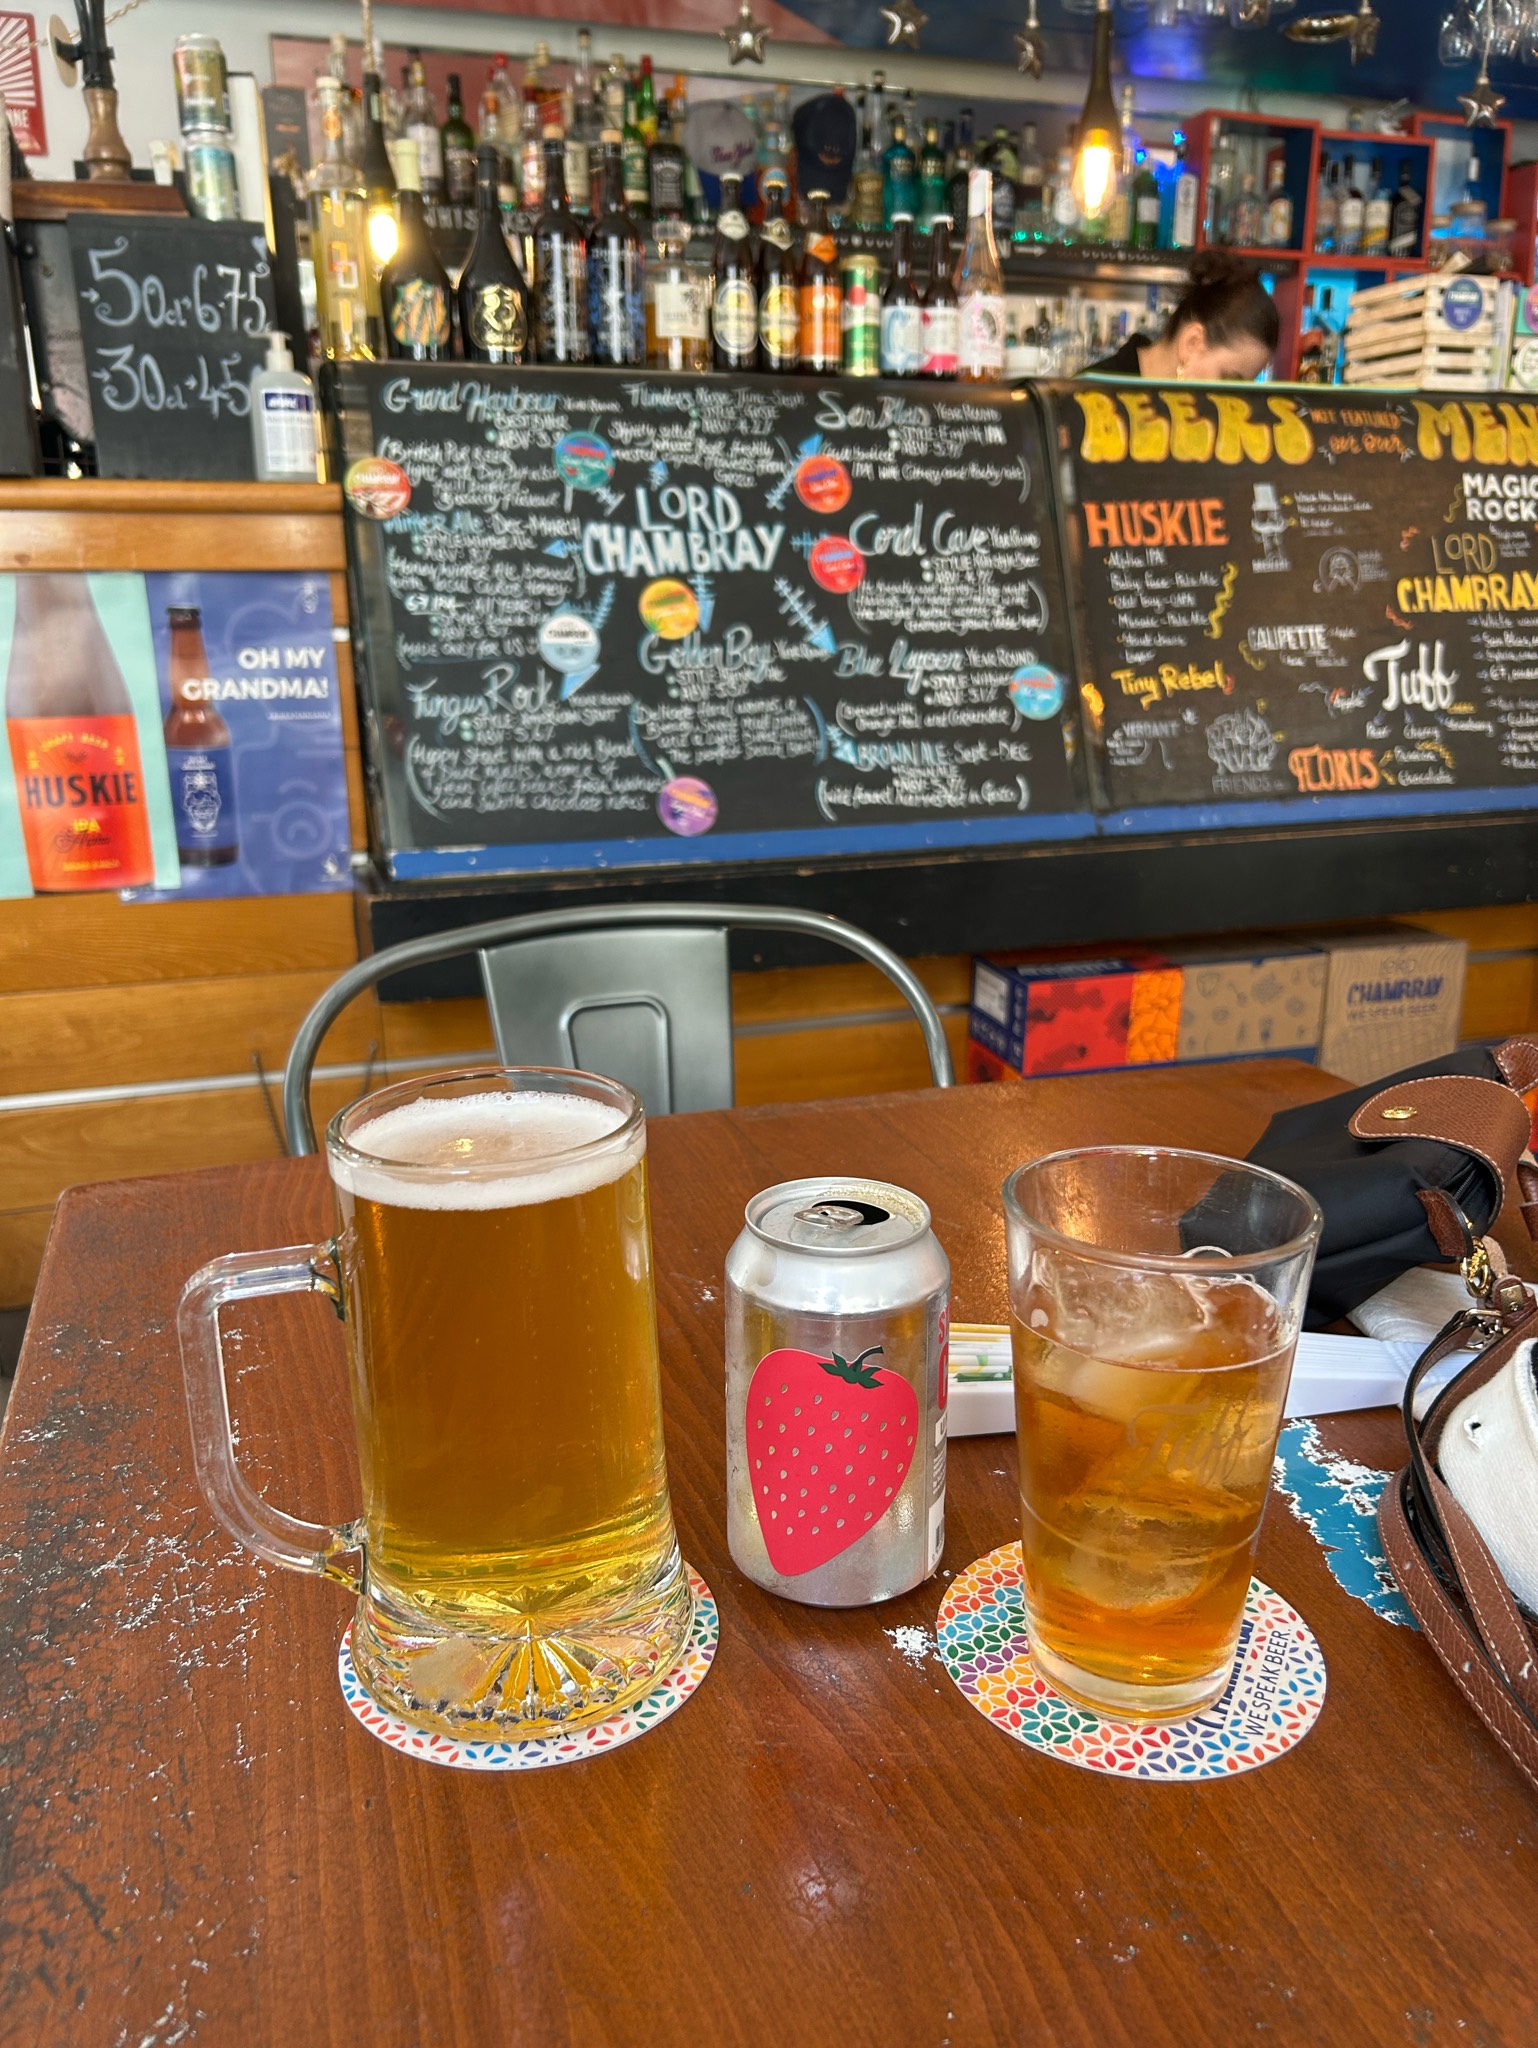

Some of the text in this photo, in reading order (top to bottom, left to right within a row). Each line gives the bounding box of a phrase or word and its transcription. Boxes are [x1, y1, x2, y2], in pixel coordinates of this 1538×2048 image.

[1073, 391, 1314, 465] BEERS
[635, 484, 742, 534] LORD
[1082, 497, 1231, 548] HUSKIE
[1465, 498, 1538, 523] ROCK
[582, 522, 785, 577] CHAMBRAY
[1431, 532, 1498, 575] LORD
[236, 646, 326, 670] OH MY
[1362, 637, 1461, 712] Tuff
[180, 675, 329, 702] GRANDMA!
[1111, 659, 1227, 711] Tiny Rebel
[24, 770, 138, 809] HUSKIE
[72, 818, 101, 833] IPA
[1251, 1664, 1281, 1711] SPEAK
[1243, 1710, 1268, 1736] WE
